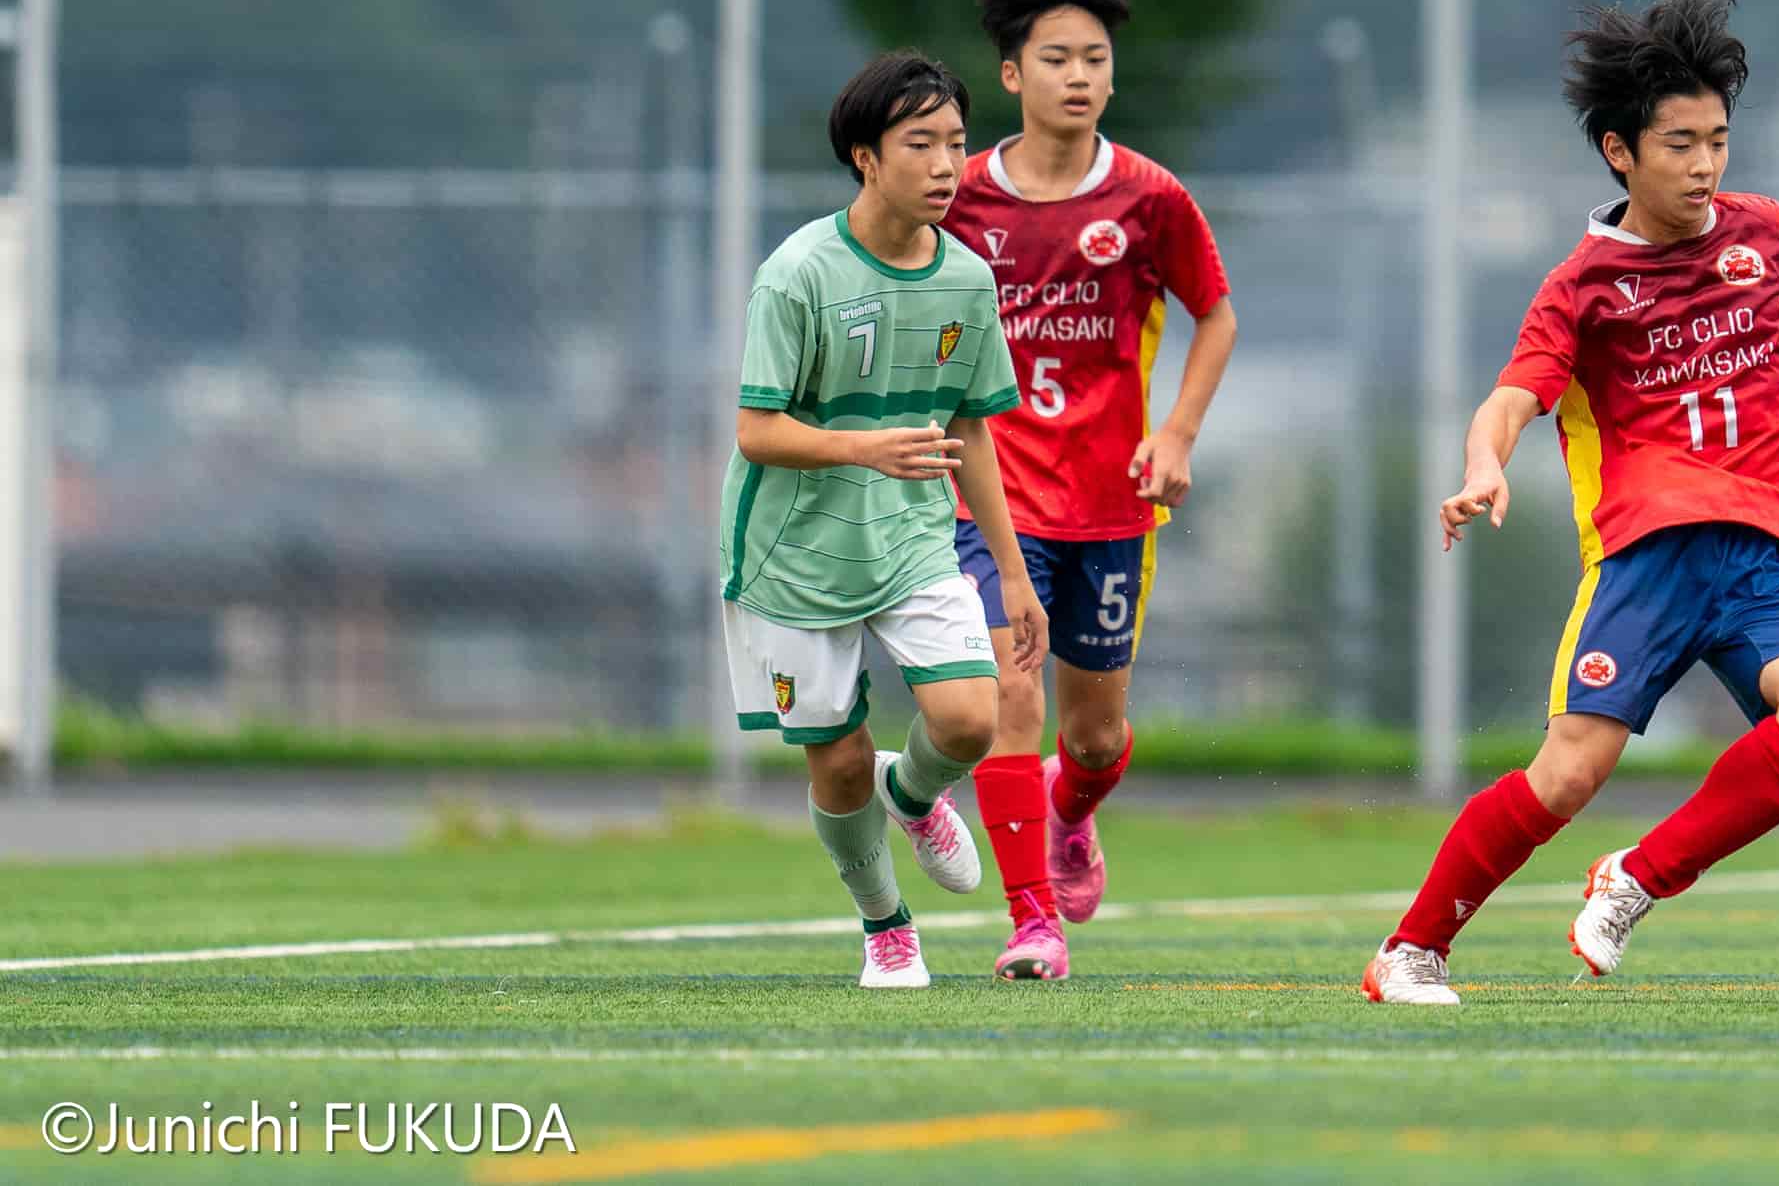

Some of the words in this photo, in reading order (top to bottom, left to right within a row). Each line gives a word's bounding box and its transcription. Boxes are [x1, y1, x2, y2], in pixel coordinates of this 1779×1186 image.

[1001, 282, 1033, 307] FC
[1042, 280, 1100, 305] CLIO
[847, 319, 877, 378] 7
[1001, 316, 1115, 341] AWASAKI
[1648, 325, 1683, 355] FC
[1691, 307, 1755, 343] CLIO
[1029, 356, 1066, 419] 5
[1632, 341, 1775, 388] KAWASAKI
[1680, 386, 1739, 452] 11
[1097, 572, 1129, 632] 5
